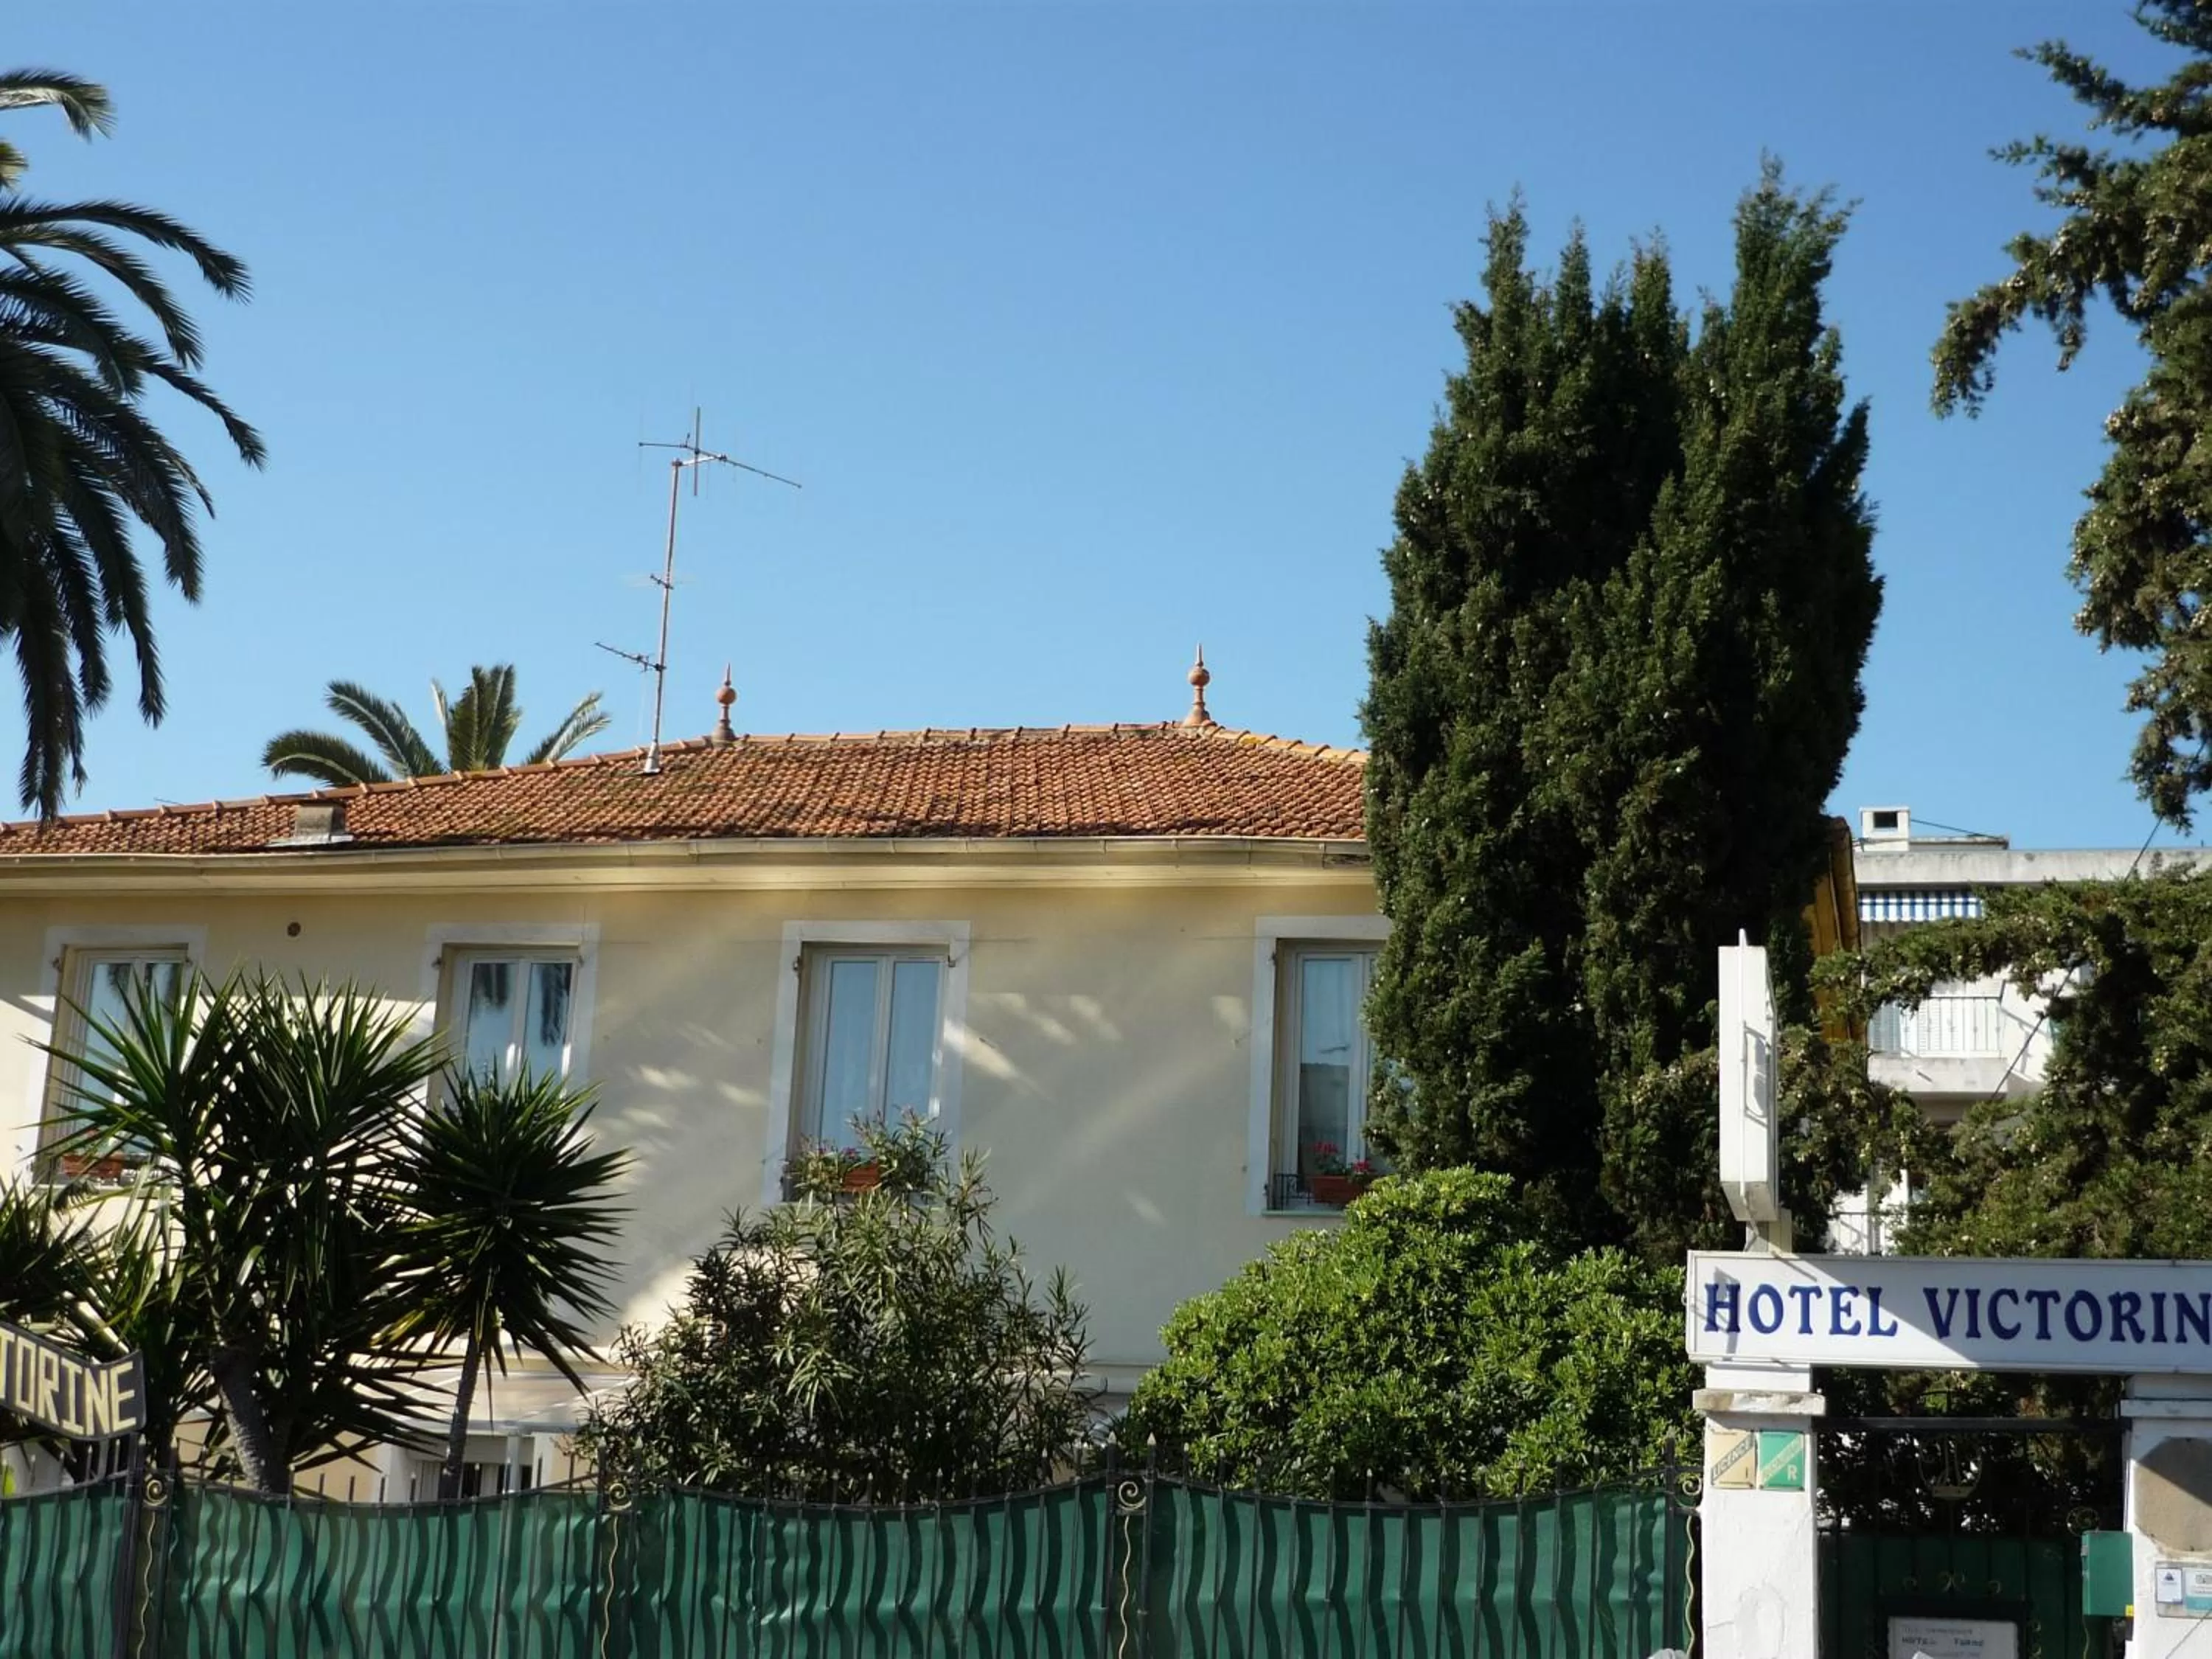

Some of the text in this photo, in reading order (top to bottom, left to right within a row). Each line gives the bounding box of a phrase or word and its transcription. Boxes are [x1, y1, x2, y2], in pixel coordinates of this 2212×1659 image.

[1703, 1284, 2212, 1344] HOTEL VICTORIN
[1787, 1464, 1798, 1481] R
